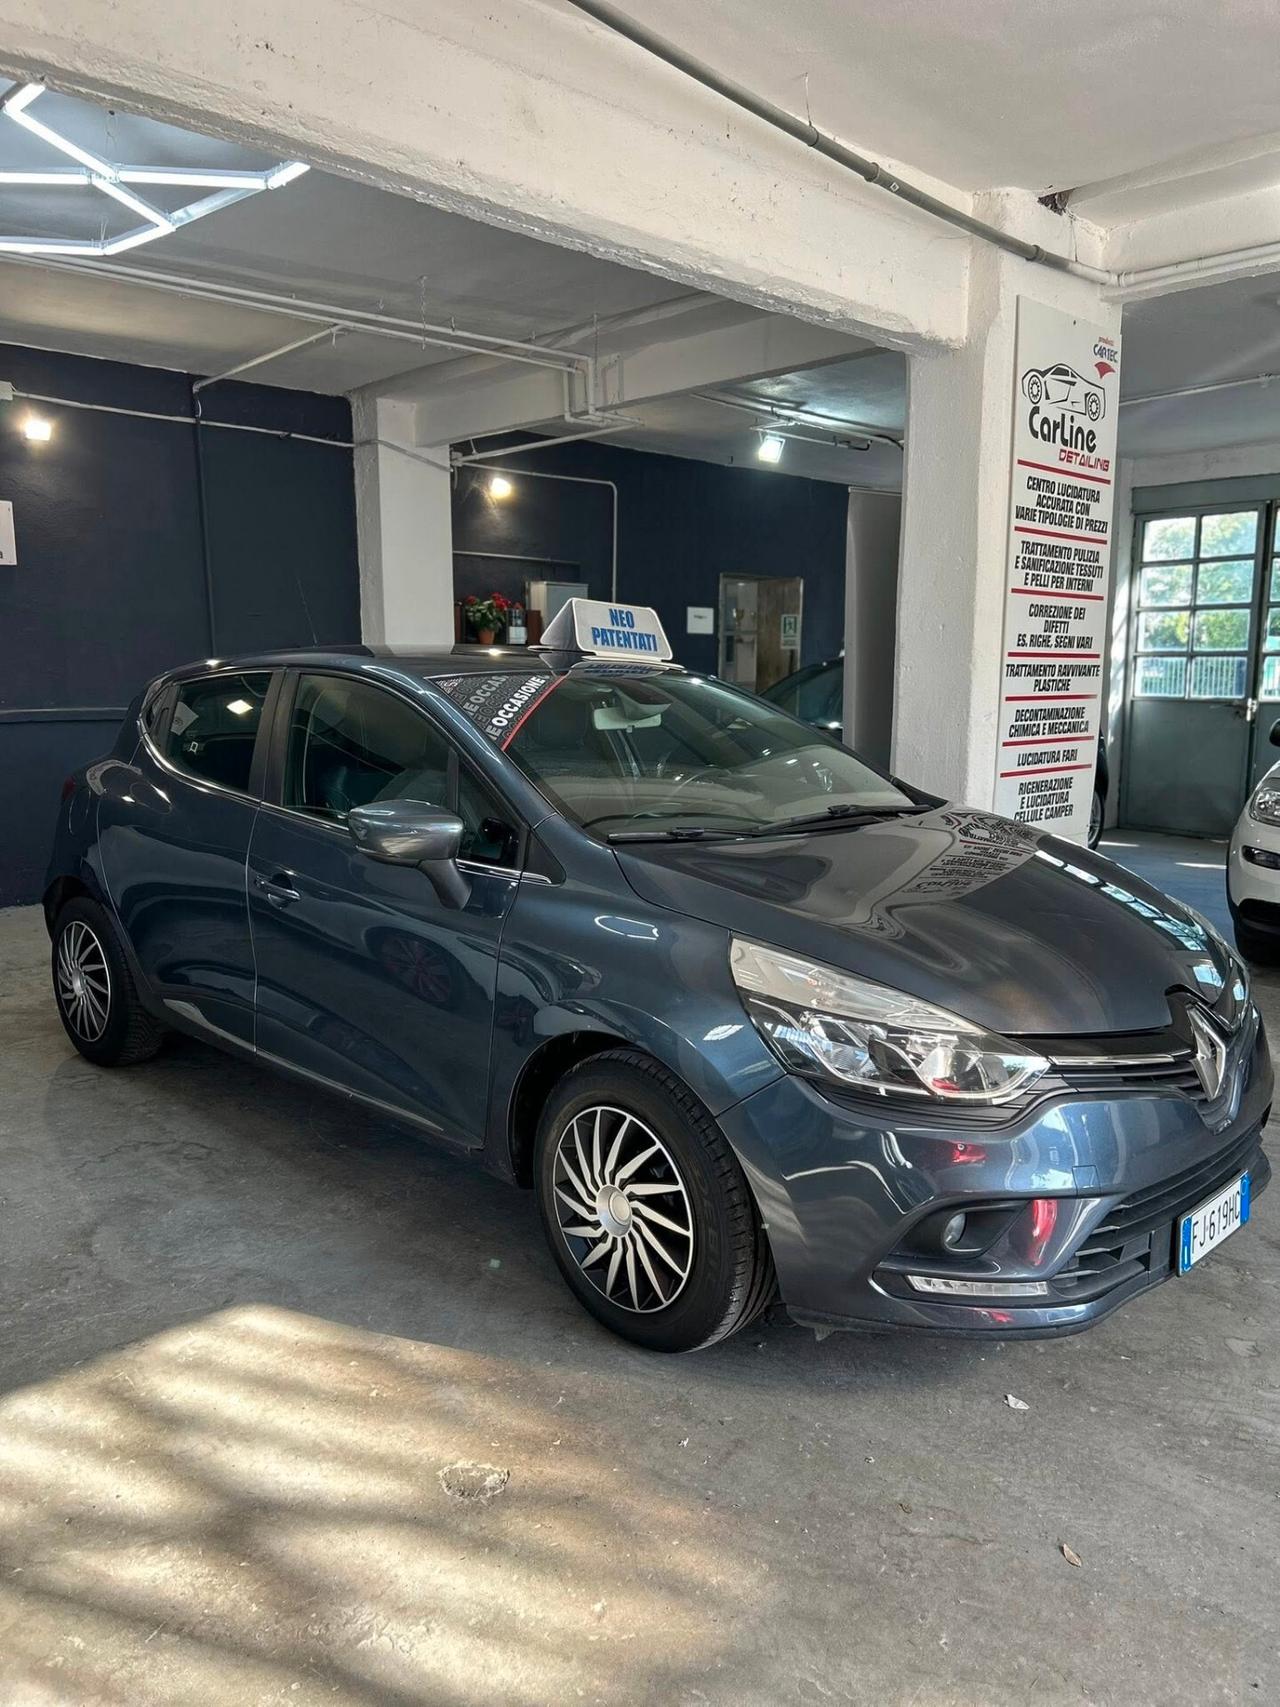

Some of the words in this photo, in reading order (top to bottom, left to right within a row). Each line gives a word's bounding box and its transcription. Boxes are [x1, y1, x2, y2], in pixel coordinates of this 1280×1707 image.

[1093, 343, 1118, 363] CARTEC
[1028, 405, 1097, 453] CarLine
[1058, 448, 1110, 472] DETAILING
[1026, 475, 1056, 496] CENTRO
[1057, 483, 1101, 504] LUCIDATURA
[1035, 493, 1074, 515] ACCURATA
[1075, 503, 1091, 517] CON
[1015, 505, 1037, 523] VARIE
[1037, 510, 1075, 530] TIPOLOGIE
[1075, 517, 1084, 530] DI
[1084, 518, 1108, 534] PREZZI
[1020, 540, 1073, 560] TRATTAMENTO
[1073, 549, 1100, 564] PULIZIA
[1014, 556, 1020, 570] E
[1020, 557, 1075, 577] SANIFICAZIONE
[1075, 564, 1104, 579] TESSUTI
[1023, 572, 1030, 586] E
[1030, 573, 1049, 588] PELLI
[1050, 575, 1064, 590] PER
[1065, 577, 1094, 592] INTERNI
[608, 608, 634, 629] NEO
[1028, 603, 1073, 620] CORREZIONE
[1074, 606, 1086, 621] DEI
[1043, 619, 1070, 634] DIFETTI
[591, 627, 658, 652] PATENTATI
[1017, 634, 1028, 647] ES.
[1029, 635, 1053, 649] RIGHE,
[1054, 636, 1075, 649] SEGNI
[1076, 636, 1093, 649] VARI
[1005, 663, 1056, 678] TRATTAMENTO
[1057, 664, 1100, 677] RAVVIVANTE
[1033, 678, 1071, 692] PLASTICHE
[1014, 706, 1085, 723] DECONTAMINAZIONE
[1008, 723, 1041, 738] CHIMICA
[1042, 722, 1048, 735] E
[1047, 719, 1089, 735] MECCANICA
[1017, 751, 1060, 767] LUCIDATURA
[1061, 748, 1078, 763] FARI
[1018, 776, 1073, 796] RIGENERAZIONE
[1020, 796, 1026, 809] E
[1026, 790, 1069, 808] LUCIDATURA
[1013, 808, 1045, 823] CELLULE
[1045, 803, 1074, 819] CAMPER
